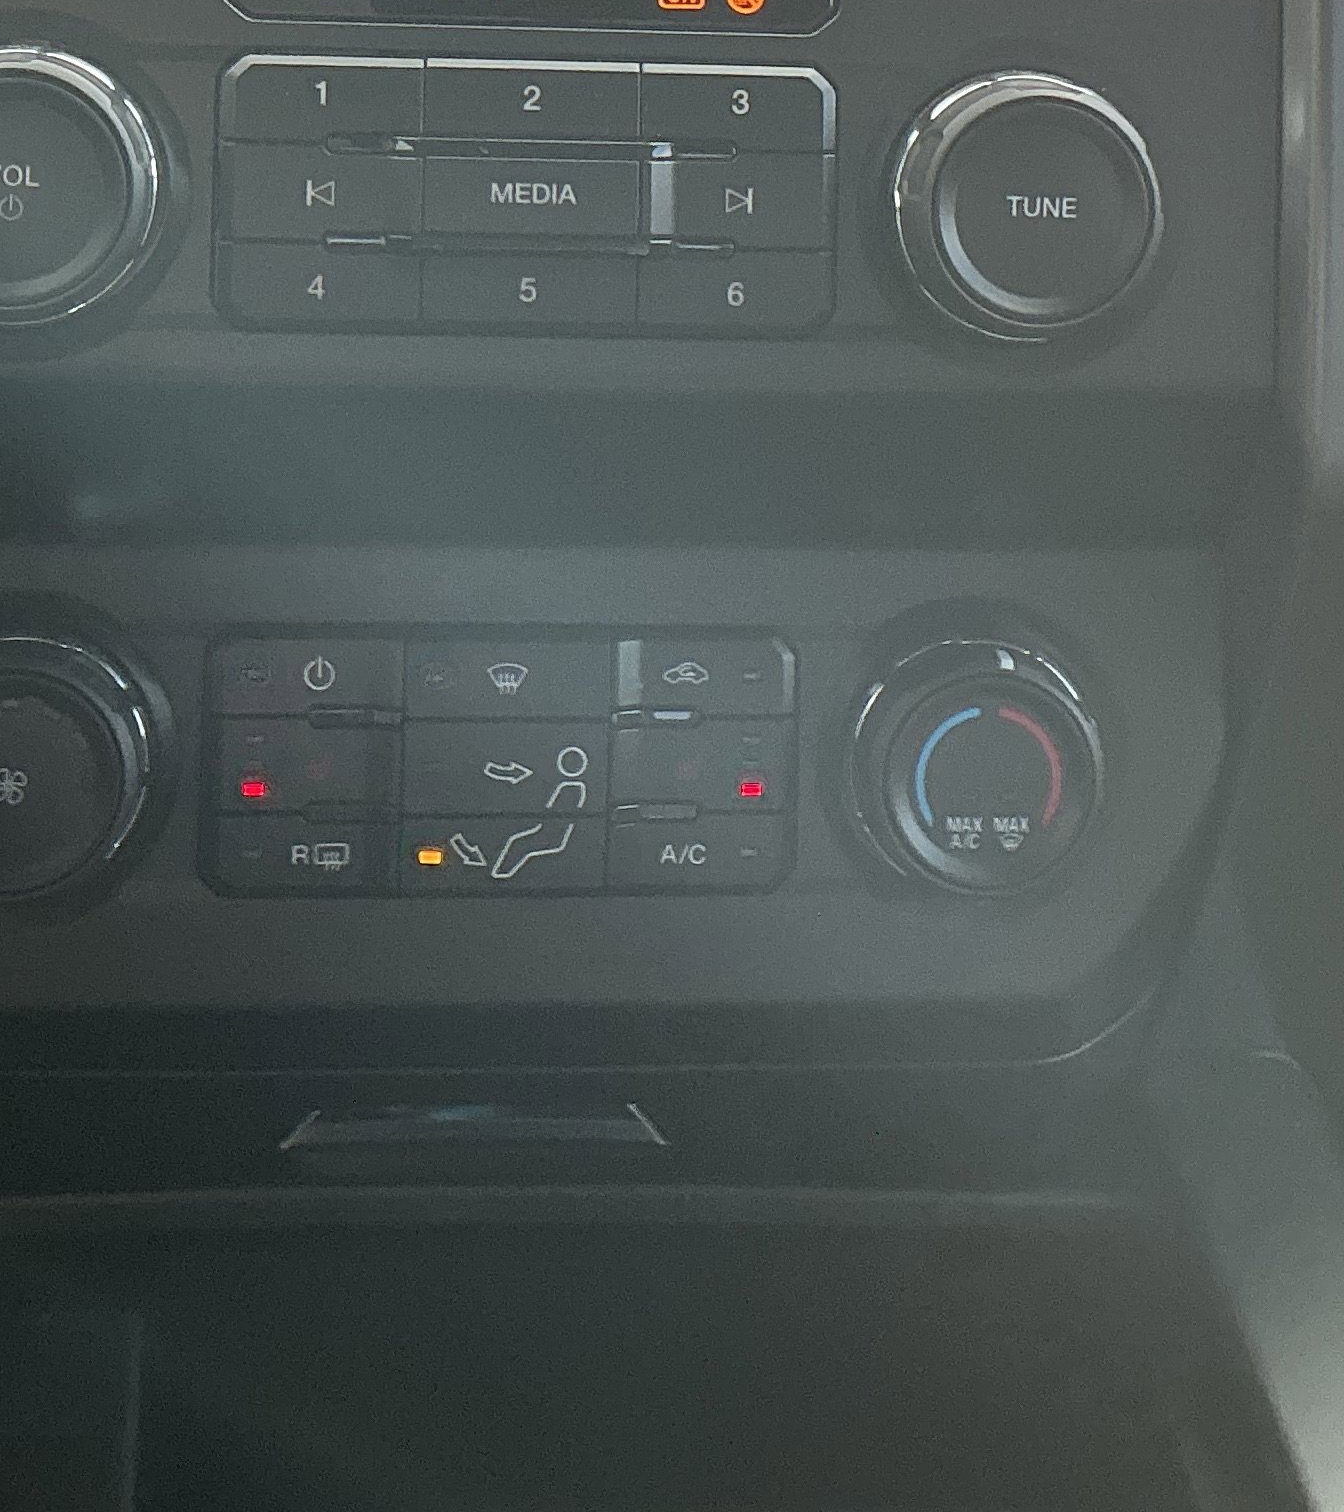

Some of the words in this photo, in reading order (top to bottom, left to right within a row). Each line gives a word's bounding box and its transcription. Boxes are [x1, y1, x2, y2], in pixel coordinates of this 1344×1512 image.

[317, 80, 326, 102] 1
[524, 84, 542, 108] 2
[732, 88, 750, 112] 3
[490, 181, 577, 203] MEDIA
[1006, 195, 1077, 216] TUNE
[307, 275, 325, 298] 4
[519, 277, 537, 301] 5
[727, 281, 744, 305] 6
[291, 845, 310, 865] R
[660, 844, 706, 866] A/C
